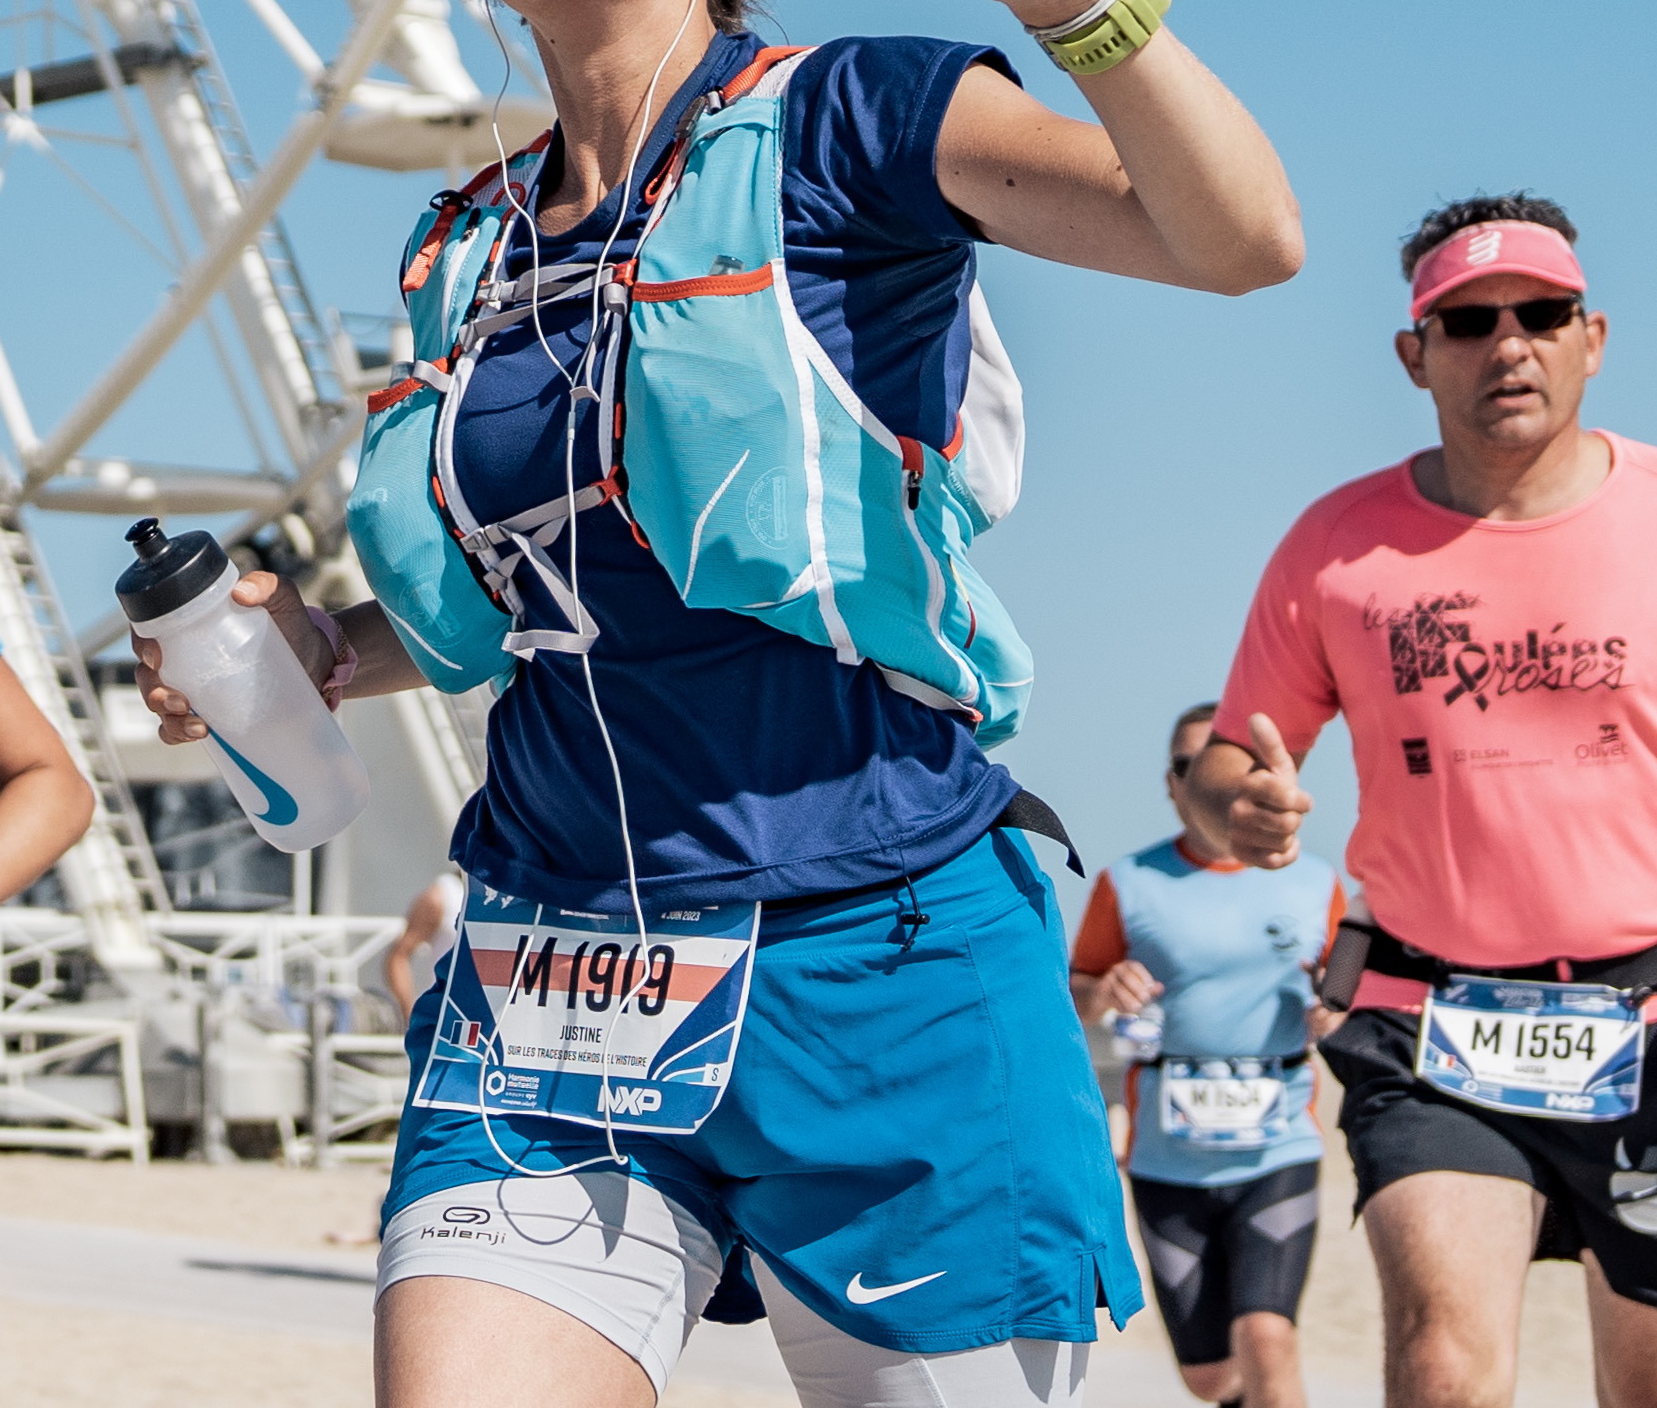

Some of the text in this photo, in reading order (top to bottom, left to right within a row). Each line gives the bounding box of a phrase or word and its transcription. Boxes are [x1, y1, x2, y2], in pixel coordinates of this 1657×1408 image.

[1575, 741, 1628, 760] Olivet
[682, 911, 701, 922] 2023
[509, 935, 675, 1015] M 1919
[559, 1025, 602, 1043] JUSTINE
[1471, 1020, 1595, 1061] M 1554
[507, 1045, 522, 1056] SUR
[523, 1046, 535, 1058] LES
[536, 1048, 563, 1061] TRACES
[563, 1050, 577, 1061] DES
[712, 1068, 719, 1082] S
[597, 1085, 662, 1116] NXP
[421, 1226, 507, 1245] Kalenji
